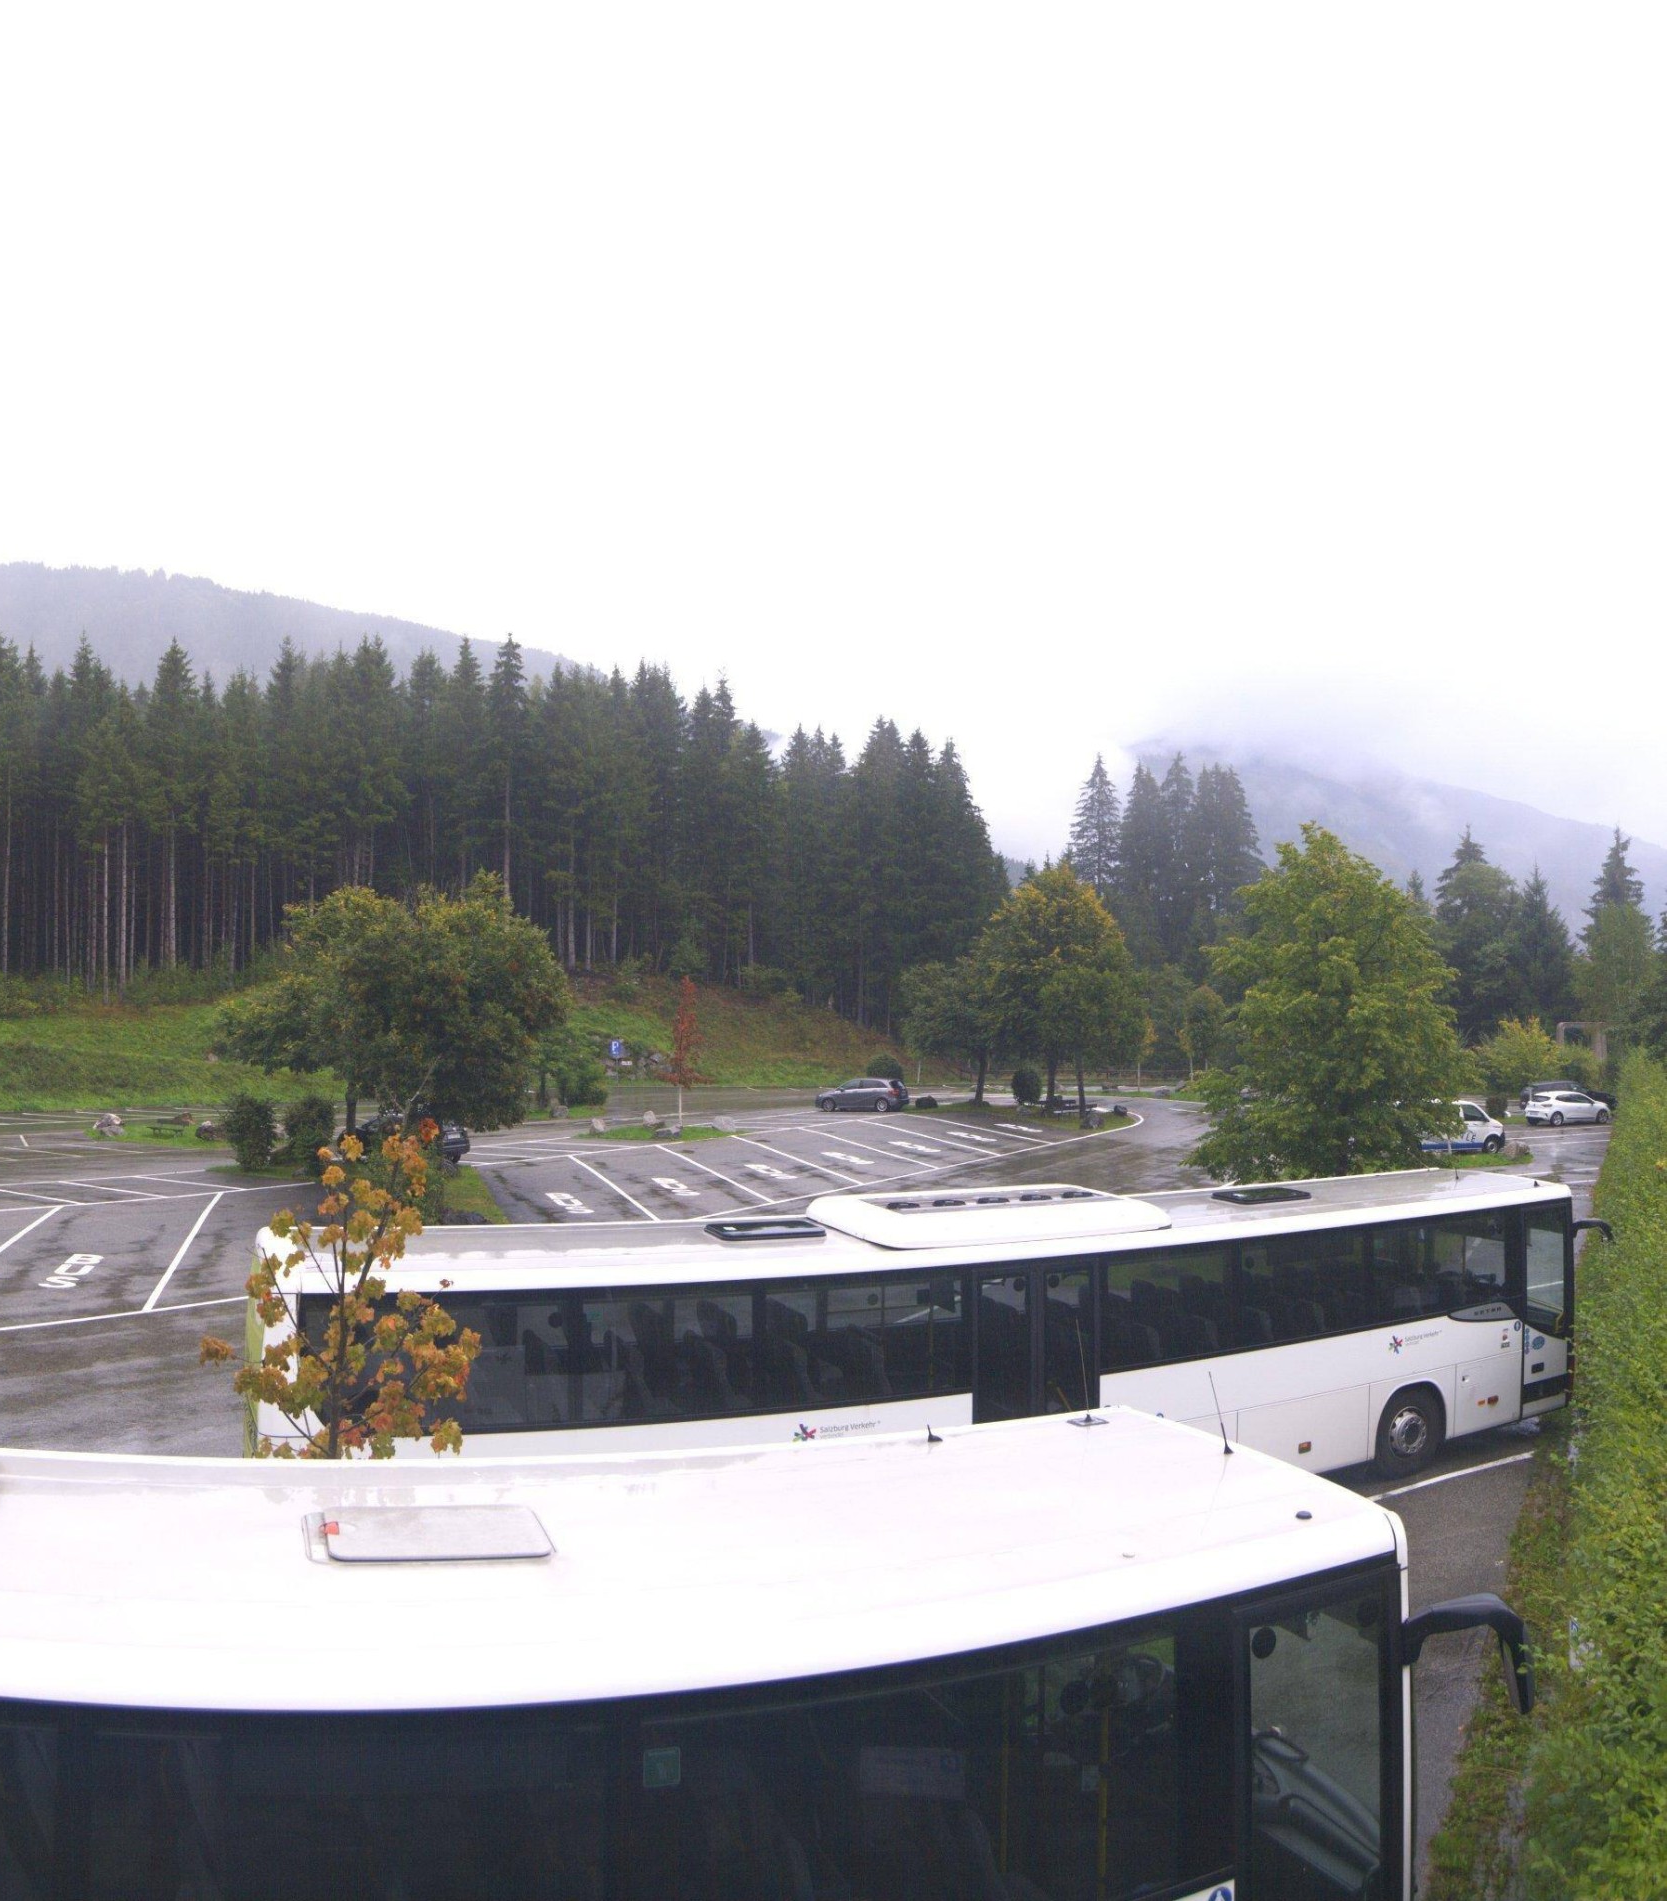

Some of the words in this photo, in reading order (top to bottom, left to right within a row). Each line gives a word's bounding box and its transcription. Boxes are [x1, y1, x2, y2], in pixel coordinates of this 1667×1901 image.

[38, 1253, 104, 1289] BUS
[1473, 1306, 1502, 1316] SETRA
[819, 1424, 849, 1433] Salzburg
[850, 1420, 876, 1430] Verkehr
